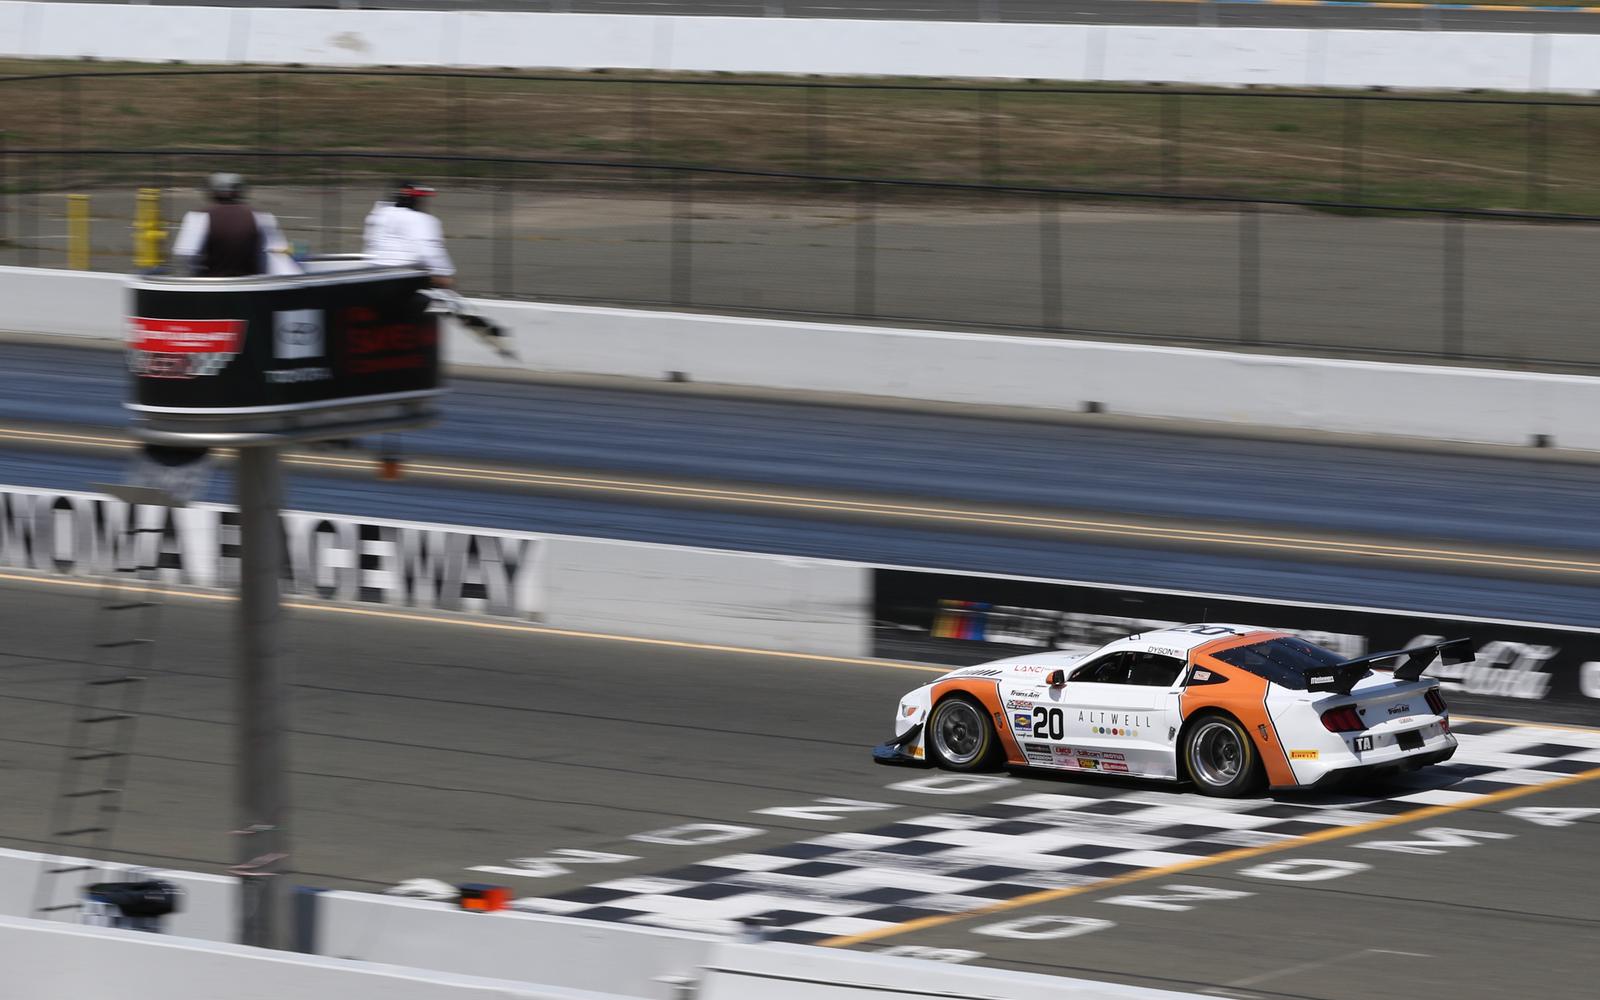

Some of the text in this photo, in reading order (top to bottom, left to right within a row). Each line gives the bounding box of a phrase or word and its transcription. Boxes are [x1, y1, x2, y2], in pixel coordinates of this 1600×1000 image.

[1147, 646, 1174, 656] DYSON
[1014, 664, 1044, 674] LANCI
[1033, 706, 1064, 740] 20
[1078, 710, 1151, 728] ALTWELL
[1355, 737, 1371, 751] TA
[1291, 751, 1317, 759] PIRELLI
